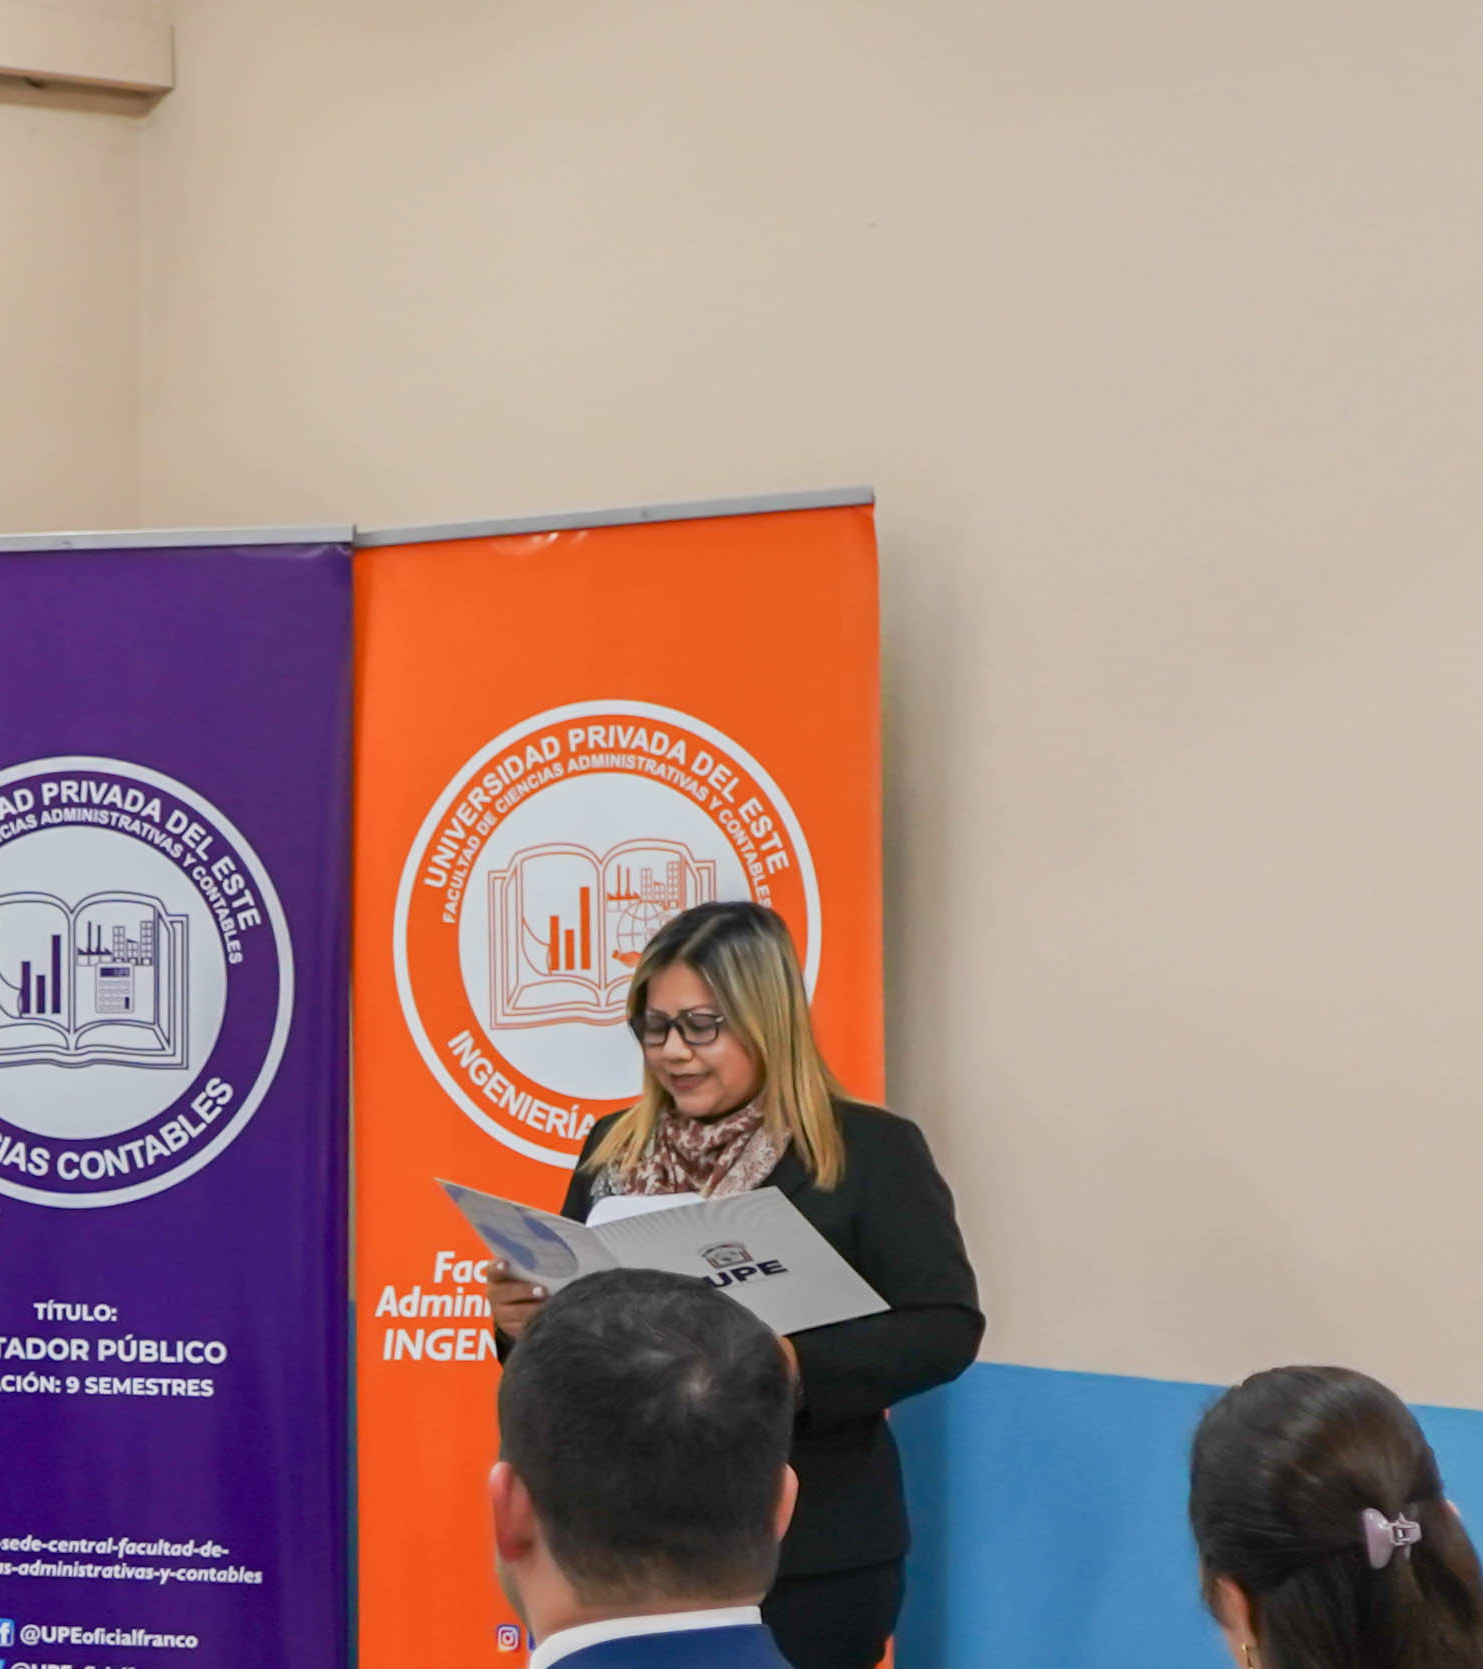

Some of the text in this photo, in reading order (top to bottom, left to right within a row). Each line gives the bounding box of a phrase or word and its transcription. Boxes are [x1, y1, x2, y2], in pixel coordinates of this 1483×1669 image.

[42, 781, 161, 822] PRIVADA
[166, 810, 212, 860] DEL
[211, 856, 261, 930] ESTE
[424, 726, 789, 887] UNIVERSIDAD PRIVADA DEL ESTE
[443, 836, 479, 922] FACULTAD
[476, 811, 499, 836] DE
[496, 763, 563, 812] CIENCIAS
[568, 754, 708, 800] ADMINISTRATIVAS
[719, 810, 771, 907] CONTABLES
[41, 808, 183, 857] ADMINISTRATIVAS
[193, 866, 242, 963] CONTABLES
[57, 1078, 233, 1180] CONTABLES
[448, 1031, 595, 1139] INGENIERÍA
[34, 1300, 117, 1321] TÍTULO:
[703, 1260, 788, 1288] UPE
[66, 1377, 79, 1393] 9
[85, 1377, 213, 1396] SEMESTRES
[98, 1335, 227, 1364] PÚBLICO
[20, 1625, 198, 1648] @UPEoficialfranco
